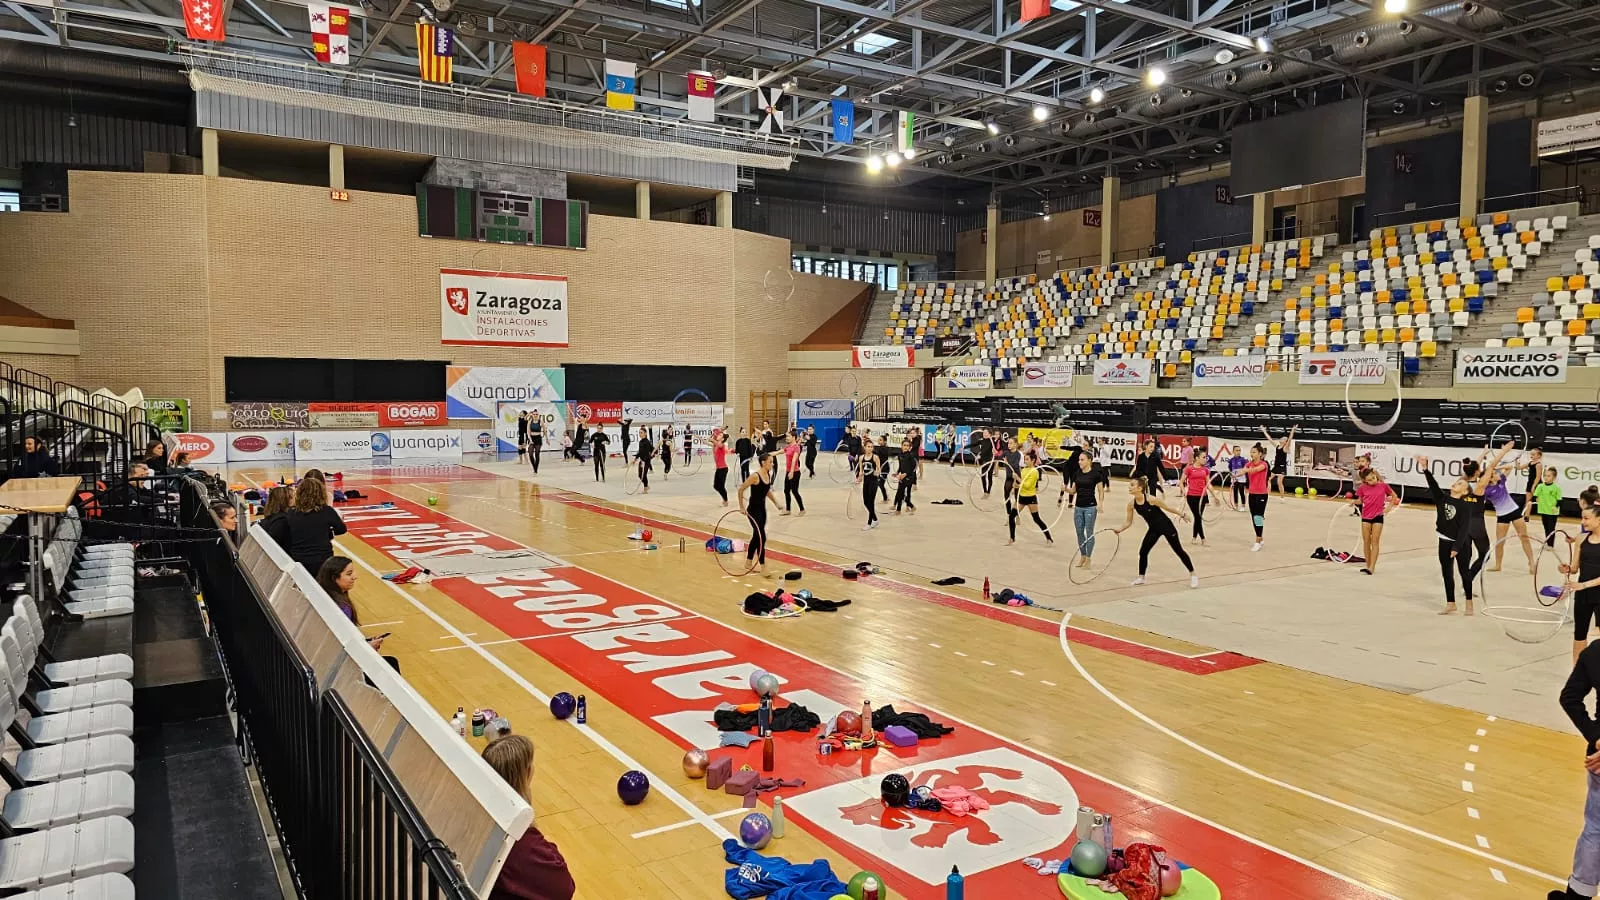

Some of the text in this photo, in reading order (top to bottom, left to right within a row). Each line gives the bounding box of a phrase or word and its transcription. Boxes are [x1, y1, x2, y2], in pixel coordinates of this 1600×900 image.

[1396, 154, 1405, 170] 14
[1217, 187, 1226, 200] 13
[1086, 212, 1095, 224] 12
[476, 291, 562, 315] Zaragoza
[476, 315, 548, 327] INSTALACIONES
[476, 326, 536, 337] DEPORTIVAS
[1472, 353, 1558, 363] AZULEJOS
[1205, 365, 1263, 374] SOLANO
[1338, 365, 1385, 377] CALLIZO
[1463, 364, 1559, 378] MONCAYO
[467, 384, 542, 401] wanapix
[234, 407, 308, 423] COLOQUIO
[390, 406, 437, 418] BOGAR
[392, 434, 461, 452] wanapix
[360, 522, 495, 560] Siglo
